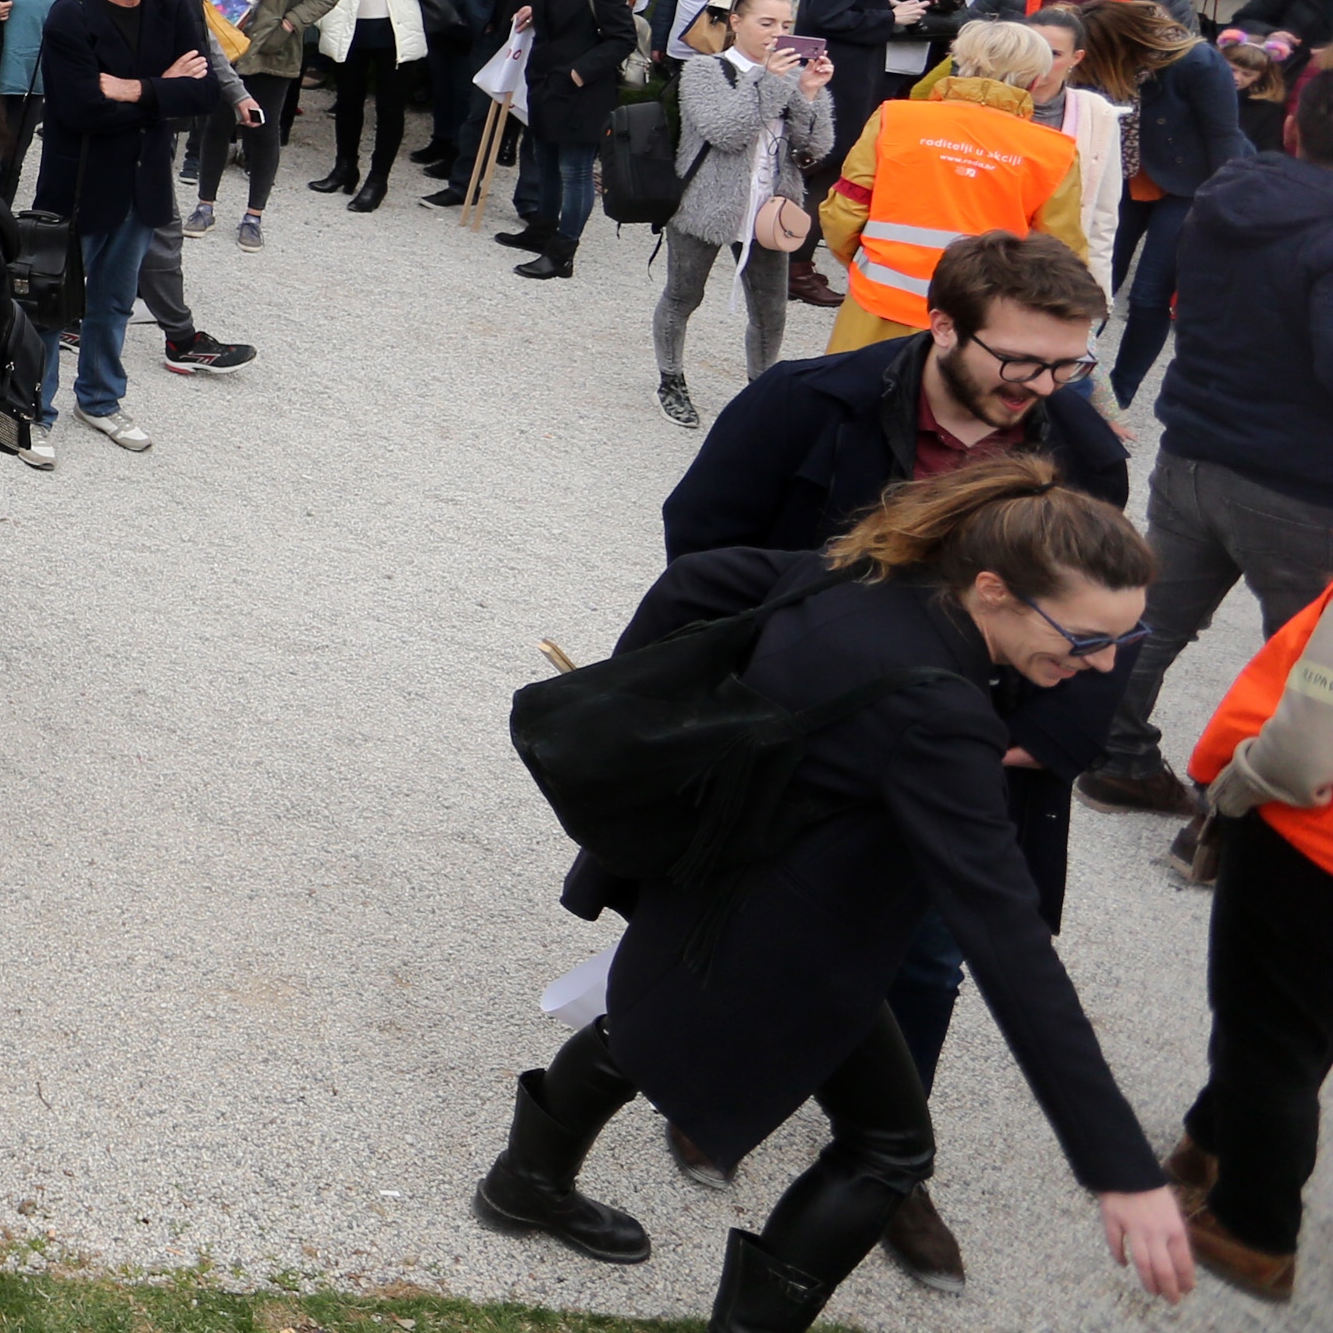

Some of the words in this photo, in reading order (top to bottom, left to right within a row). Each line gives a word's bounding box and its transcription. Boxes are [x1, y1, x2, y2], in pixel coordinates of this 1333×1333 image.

[919, 138, 973, 154] roditelji
[975, 148, 984, 157] u
[986, 150, 1023, 166] akciji
